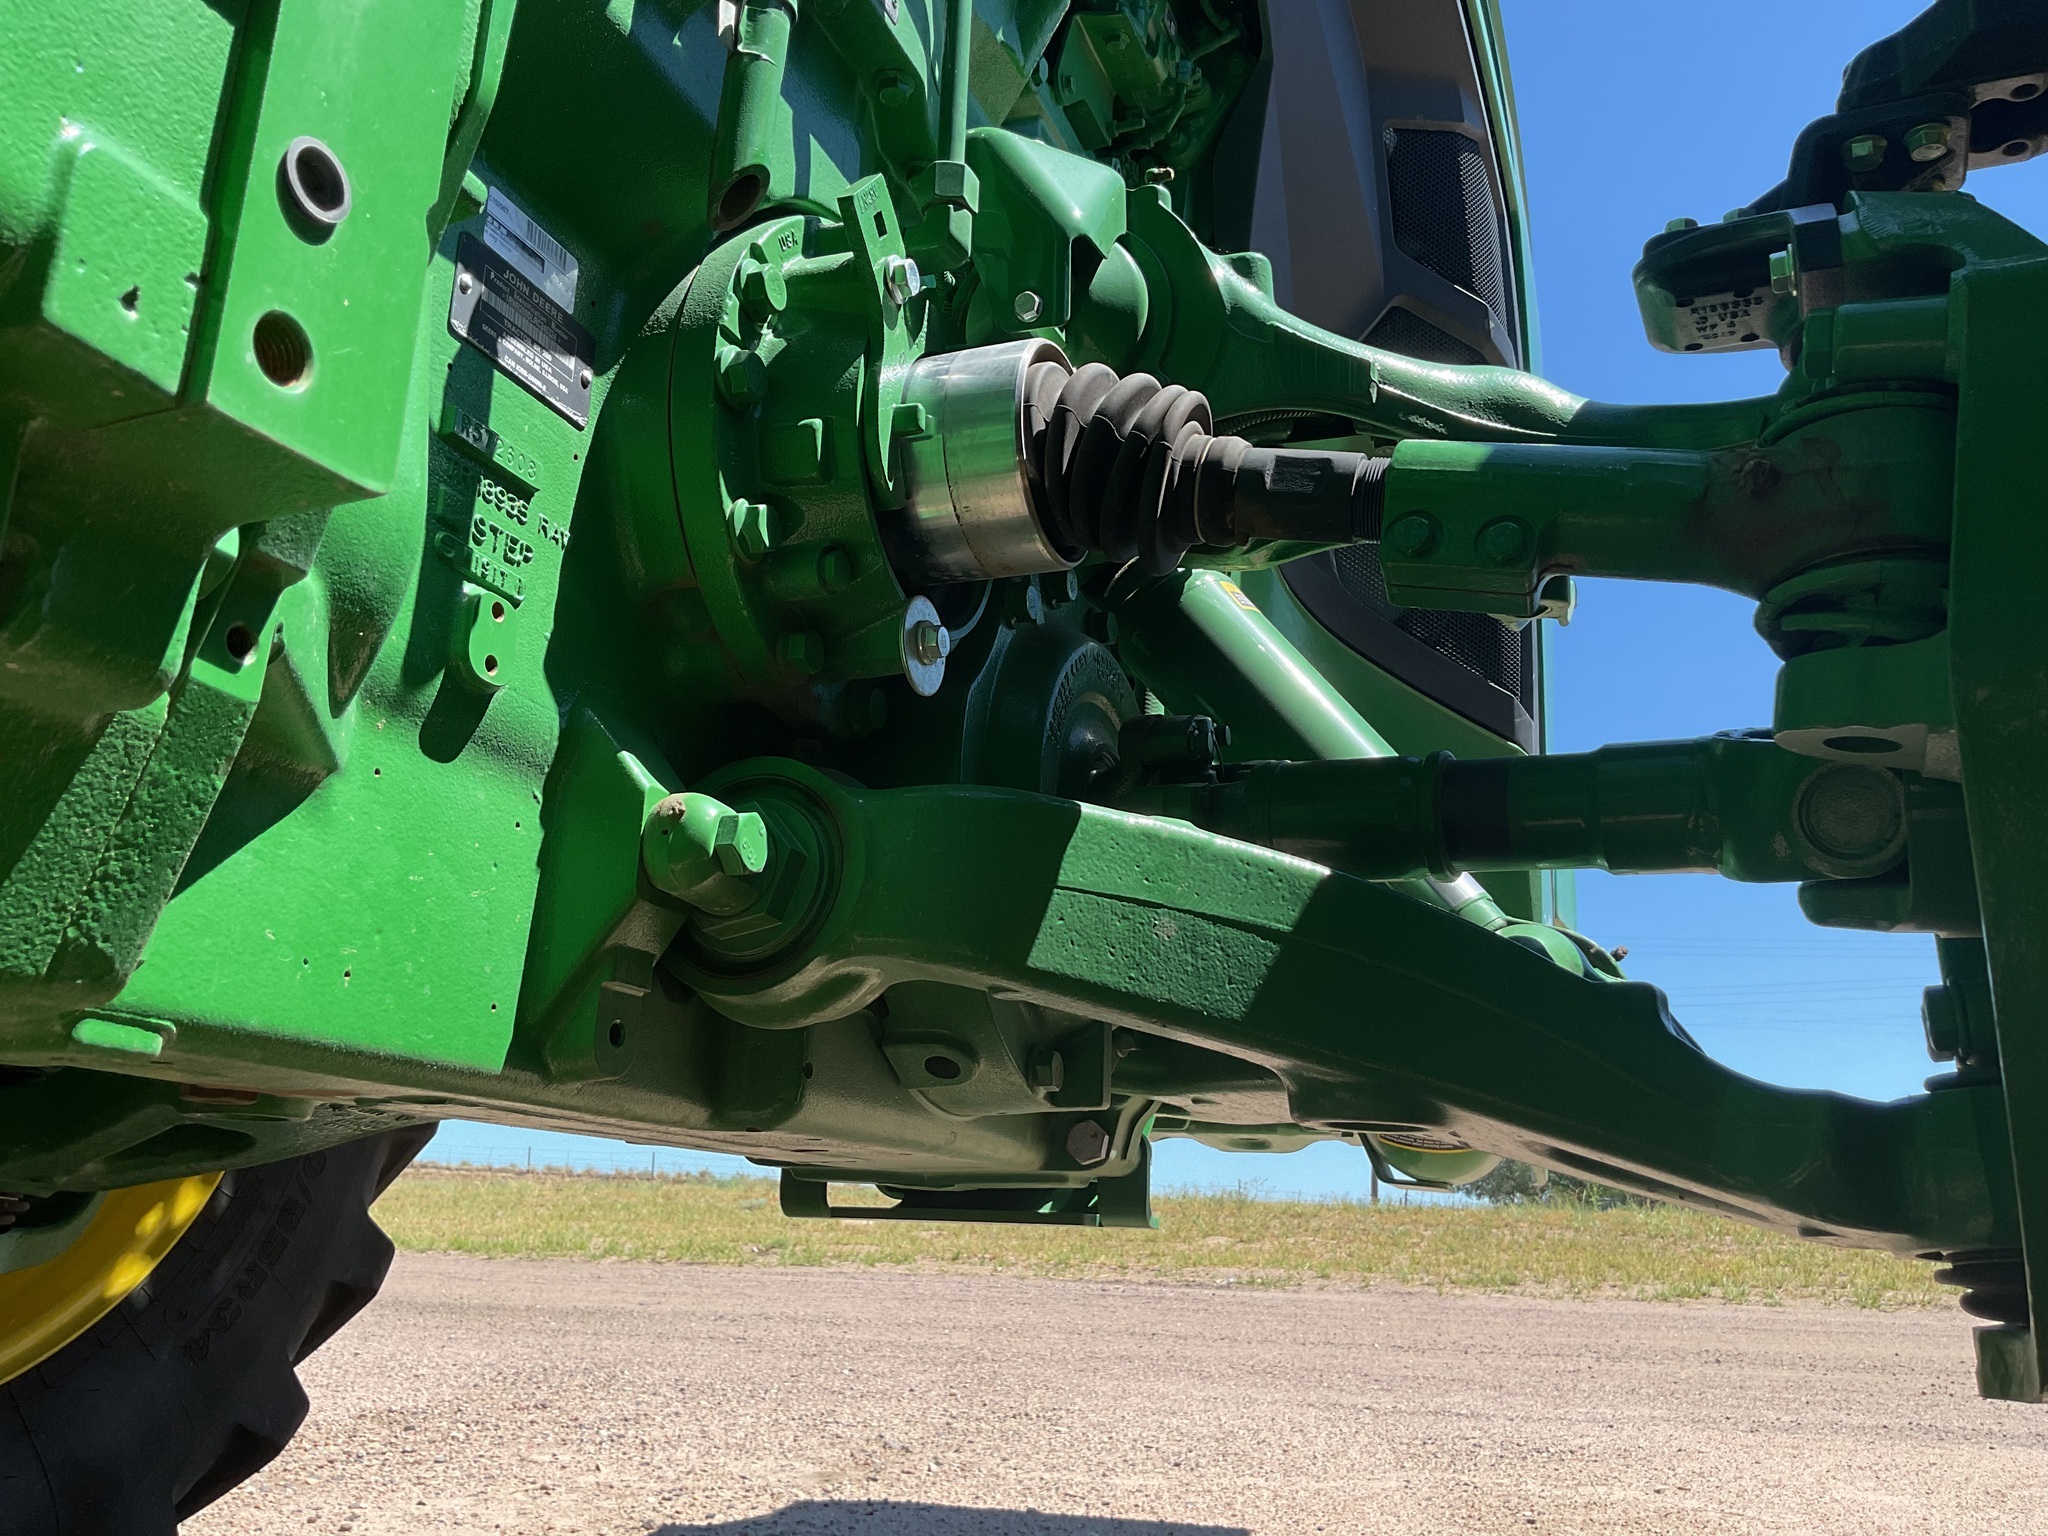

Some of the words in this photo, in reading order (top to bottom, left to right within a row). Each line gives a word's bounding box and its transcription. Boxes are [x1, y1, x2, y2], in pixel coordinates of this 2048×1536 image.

[778, 228, 798, 252] USA
[490, 273, 509, 292] Product
[514, 292, 546, 322] Identification
[551, 322, 568, 340] Number
[503, 269, 529, 295] JOHN
[532, 292, 563, 323] DEERE
[502, 332, 533, 358] ASSEMBLED
[534, 355, 540, 365] IN
[541, 361, 552, 374] USA
[503, 320, 531, 345] TRACTOR
[481, 324, 497, 338] DEERE
[502, 340, 524, 361] COMPANY,
[525, 359, 541, 374] MOLINE,
[559, 383, 568, 394] USA
[504, 354, 515, 367] CAN
[471, 513, 534, 568] STEP
